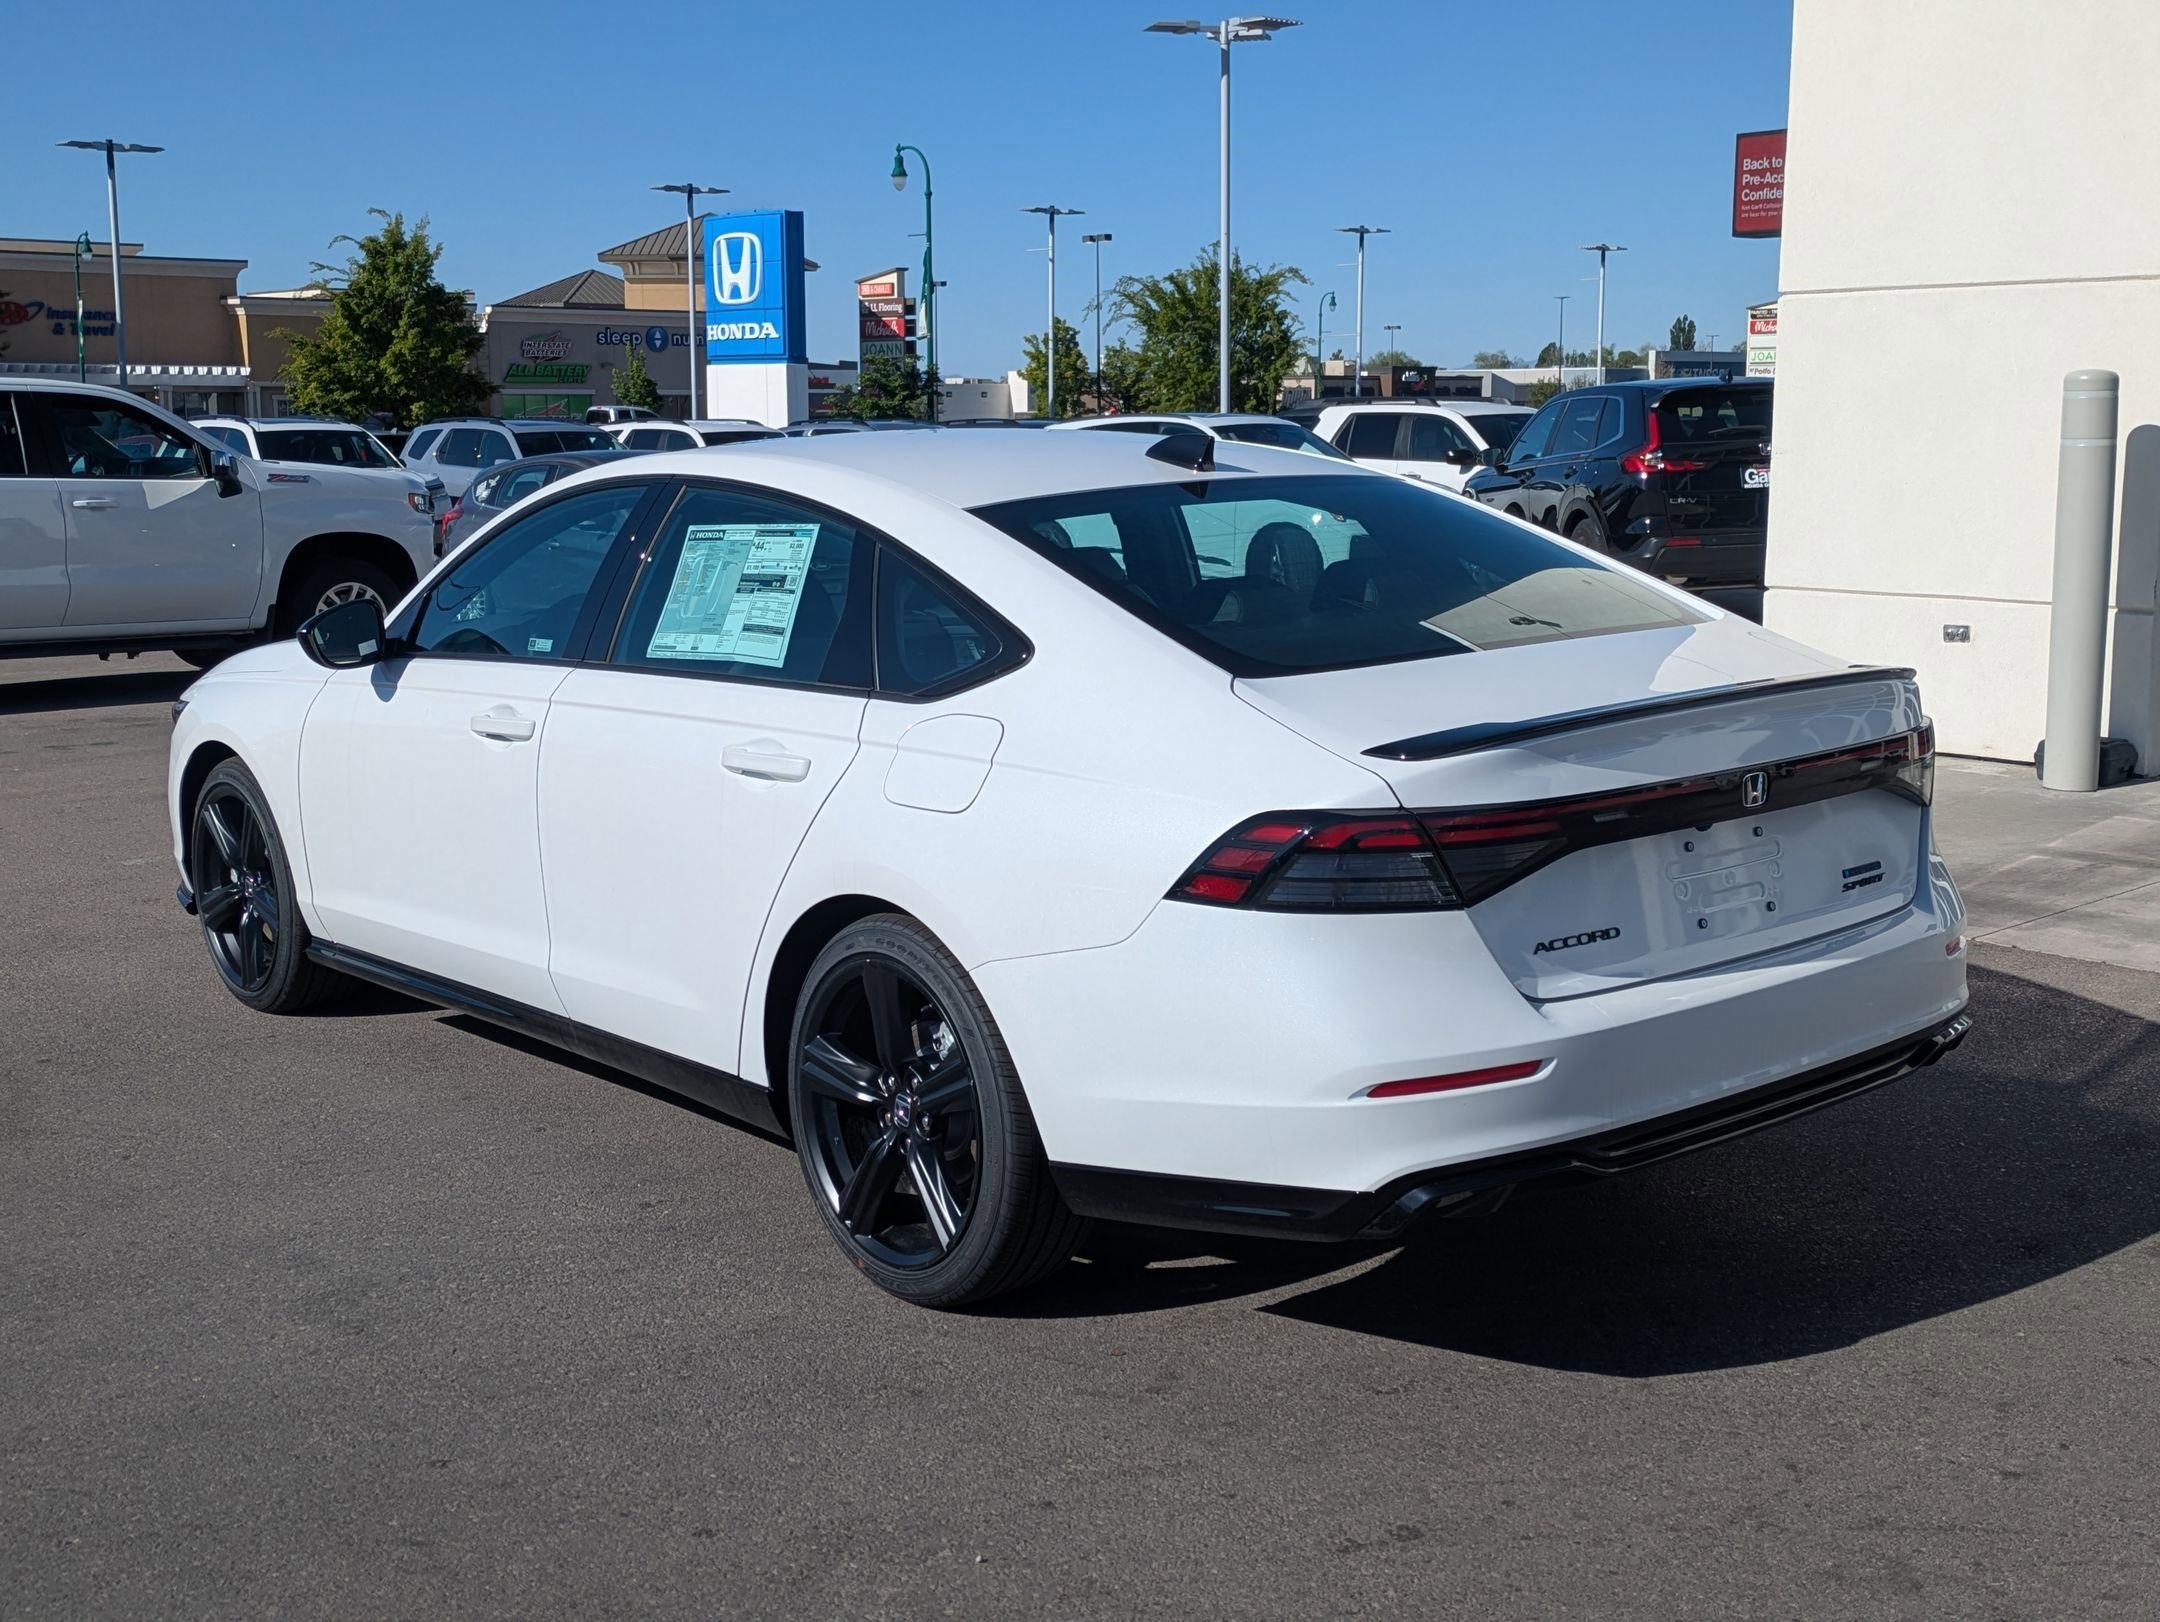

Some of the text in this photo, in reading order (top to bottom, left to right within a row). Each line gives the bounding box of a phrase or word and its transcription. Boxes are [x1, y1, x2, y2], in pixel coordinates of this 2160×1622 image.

[1743, 156, 1783, 171] Back to
[878, 303, 903, 313] Flooring
[52, 322, 116, 336] & Tavel
[706, 322, 780, 341] HONDA
[598, 328, 642, 349] sleep
[863, 343, 903, 356] JOANN
[508, 364, 591, 377] ALL BATTERY
[1744, 469, 1770, 484] Ga
[695, 532, 724, 540] HONDA
[1841, 872, 1886, 893] SPORT
[1532, 926, 1622, 956] ACCORD
